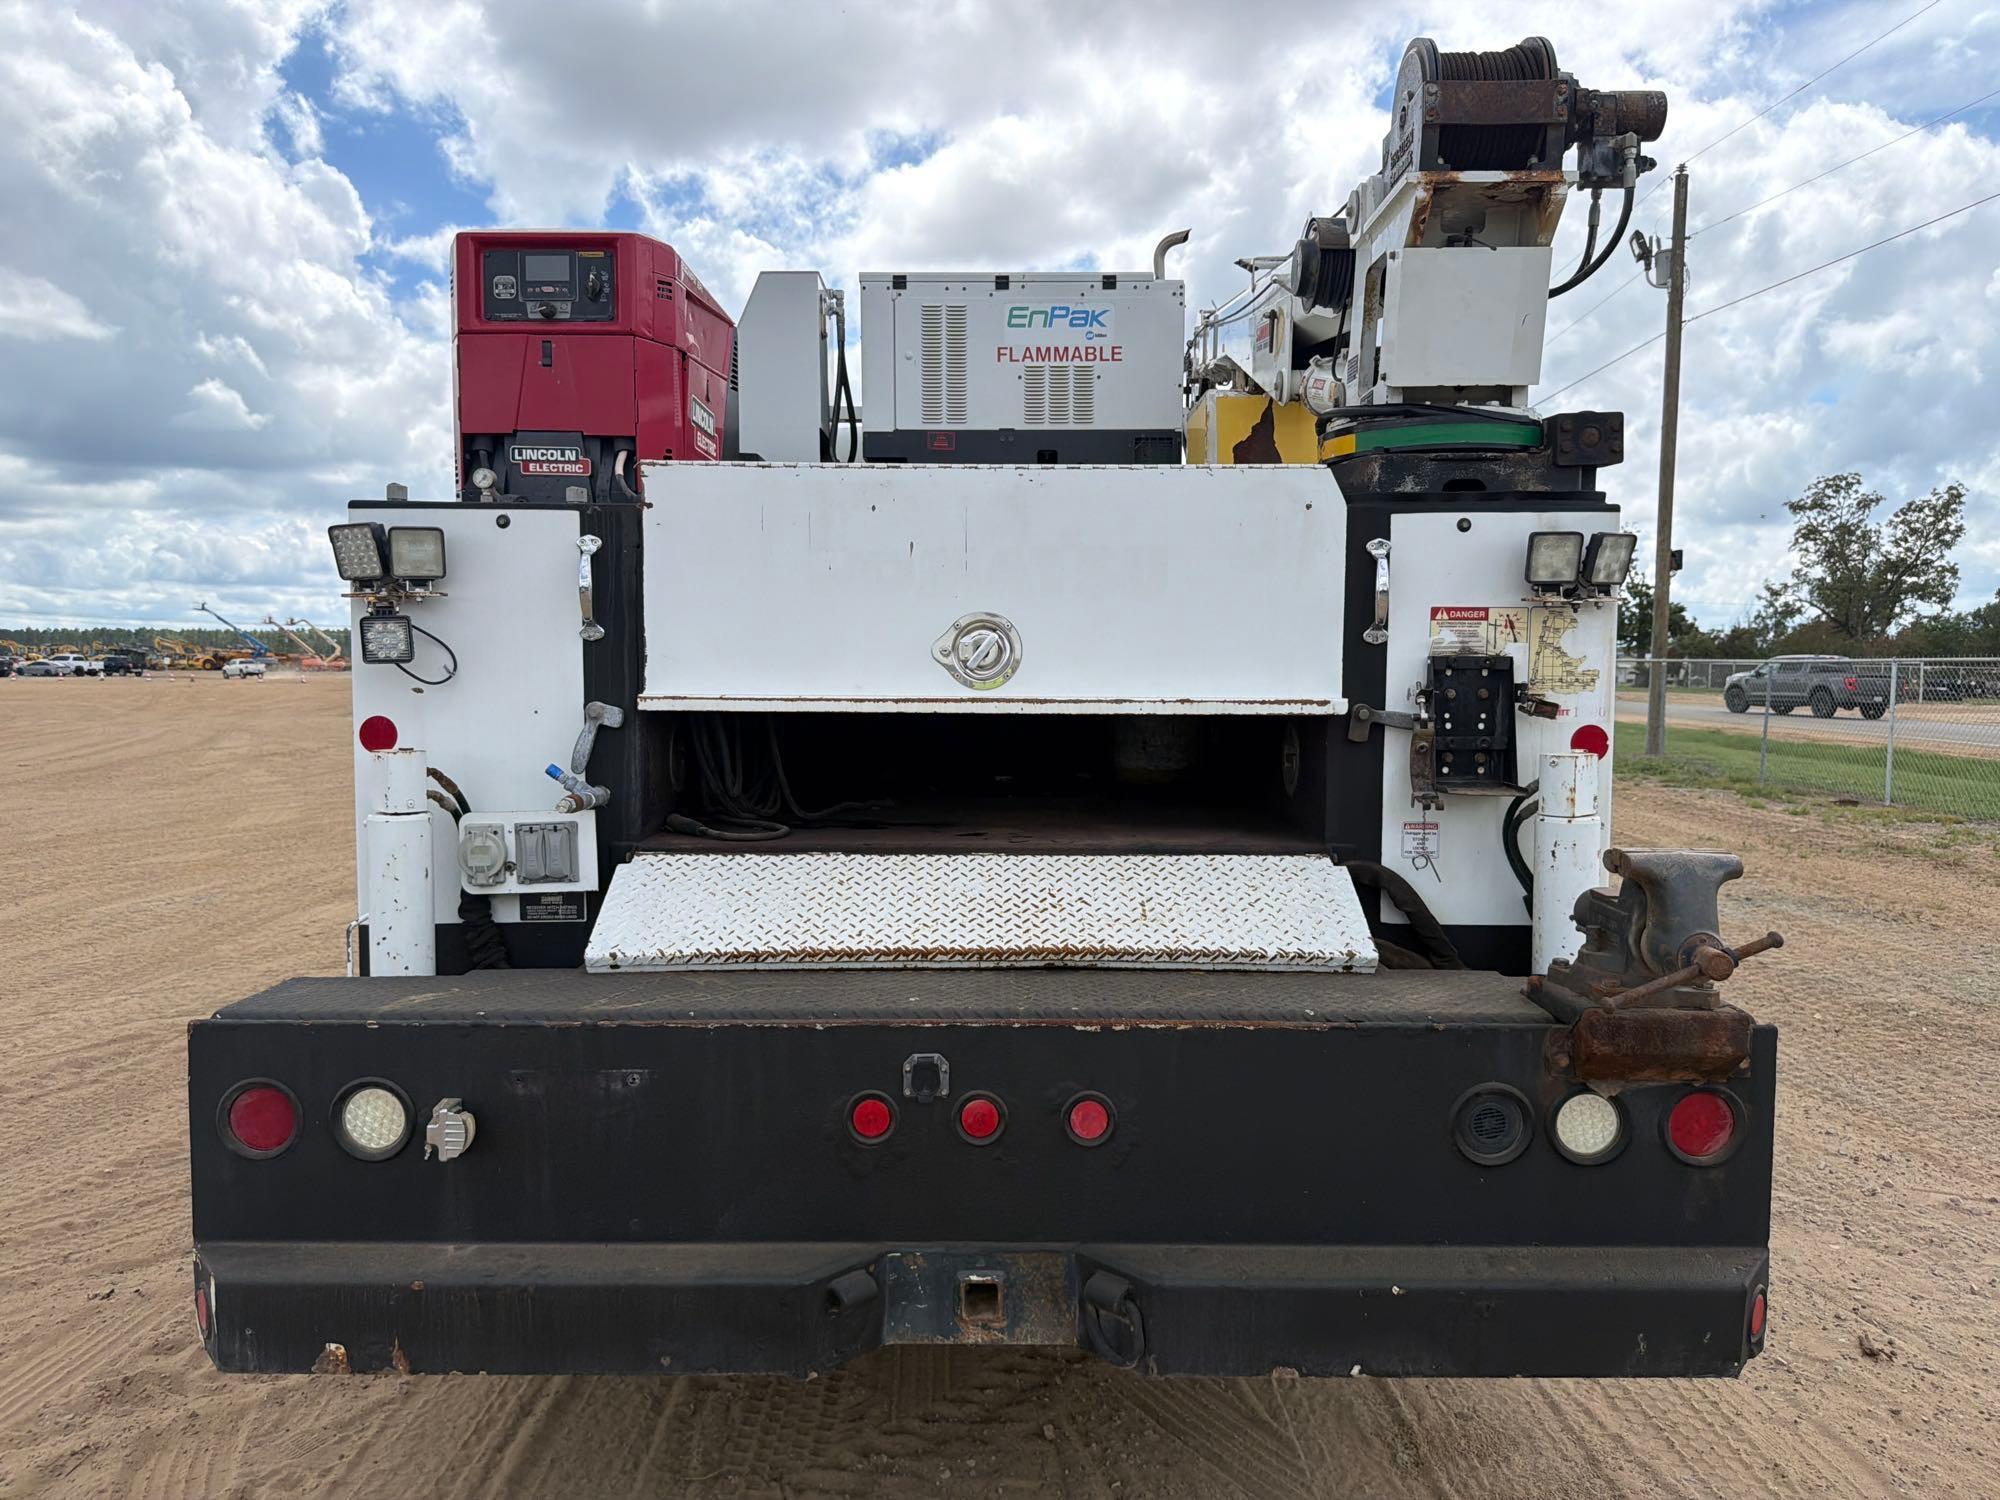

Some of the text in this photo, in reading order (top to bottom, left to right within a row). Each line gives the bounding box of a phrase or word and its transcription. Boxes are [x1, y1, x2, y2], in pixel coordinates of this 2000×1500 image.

[1007, 306, 1112, 328] EnPak
[997, 346, 1123, 363] FLAMMABLE
[692, 399, 715, 436] LINCOLN
[697, 432, 717, 457] ELECTRIC
[514, 449, 576, 461] LINCOLN
[528, 463, 584, 473] ELECTRIC
[1449, 610, 1486, 618] DANGER
